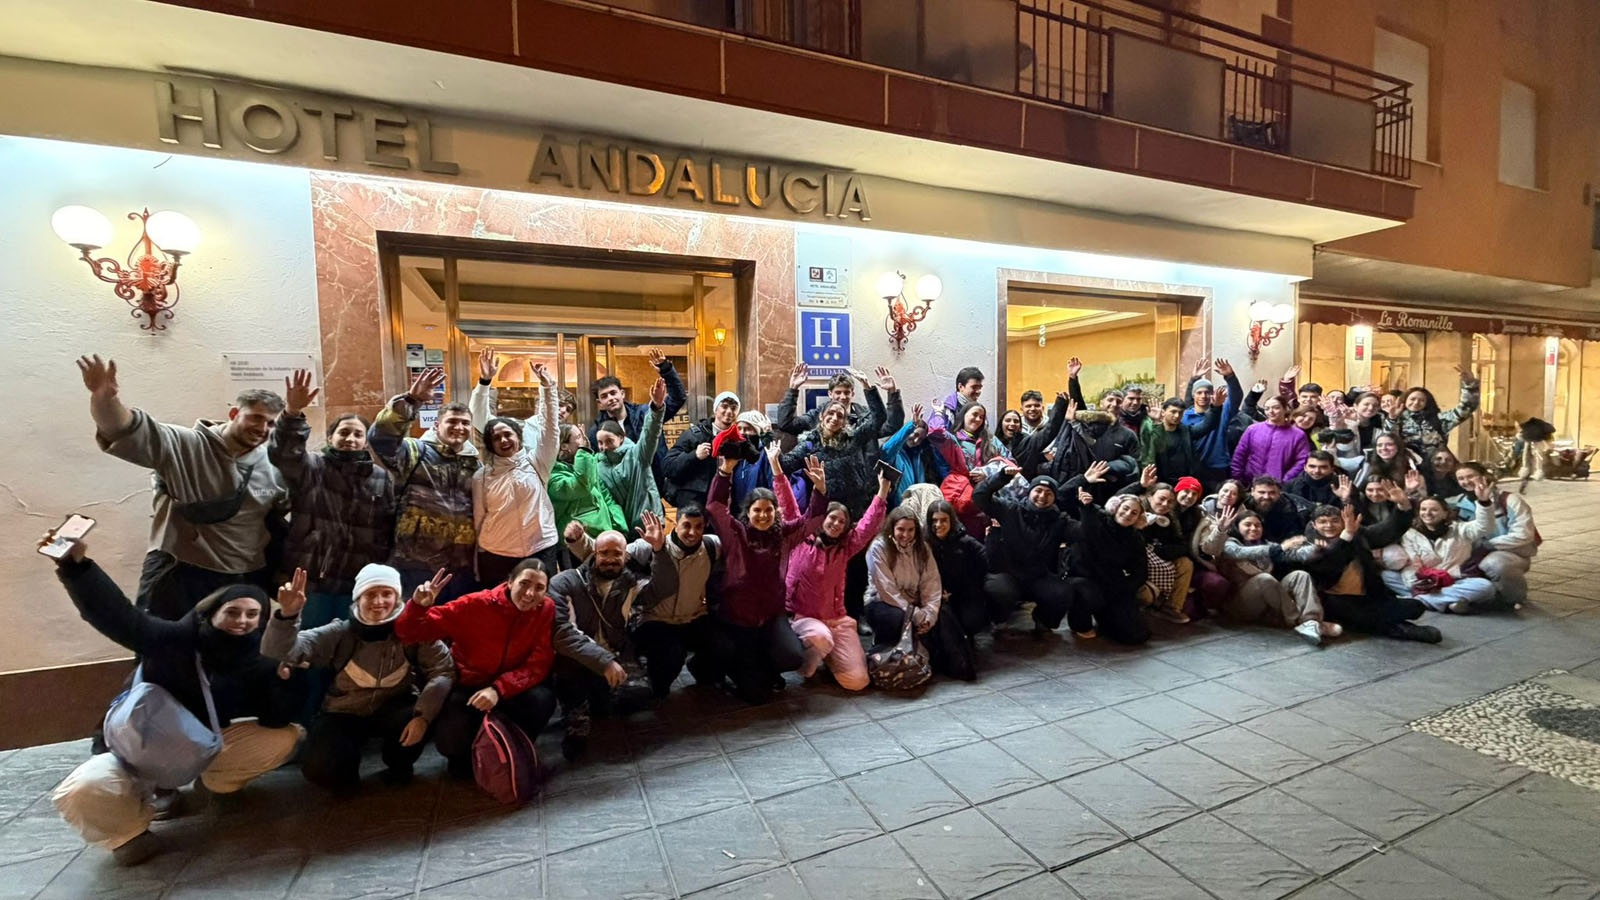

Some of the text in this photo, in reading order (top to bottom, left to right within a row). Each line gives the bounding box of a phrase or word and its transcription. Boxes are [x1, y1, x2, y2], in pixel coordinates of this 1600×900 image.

[154, 79, 872, 222] HOTEL ANDALUCIA
[810, 317, 842, 348] H
[1376, 310, 1454, 331] La Romanilla
